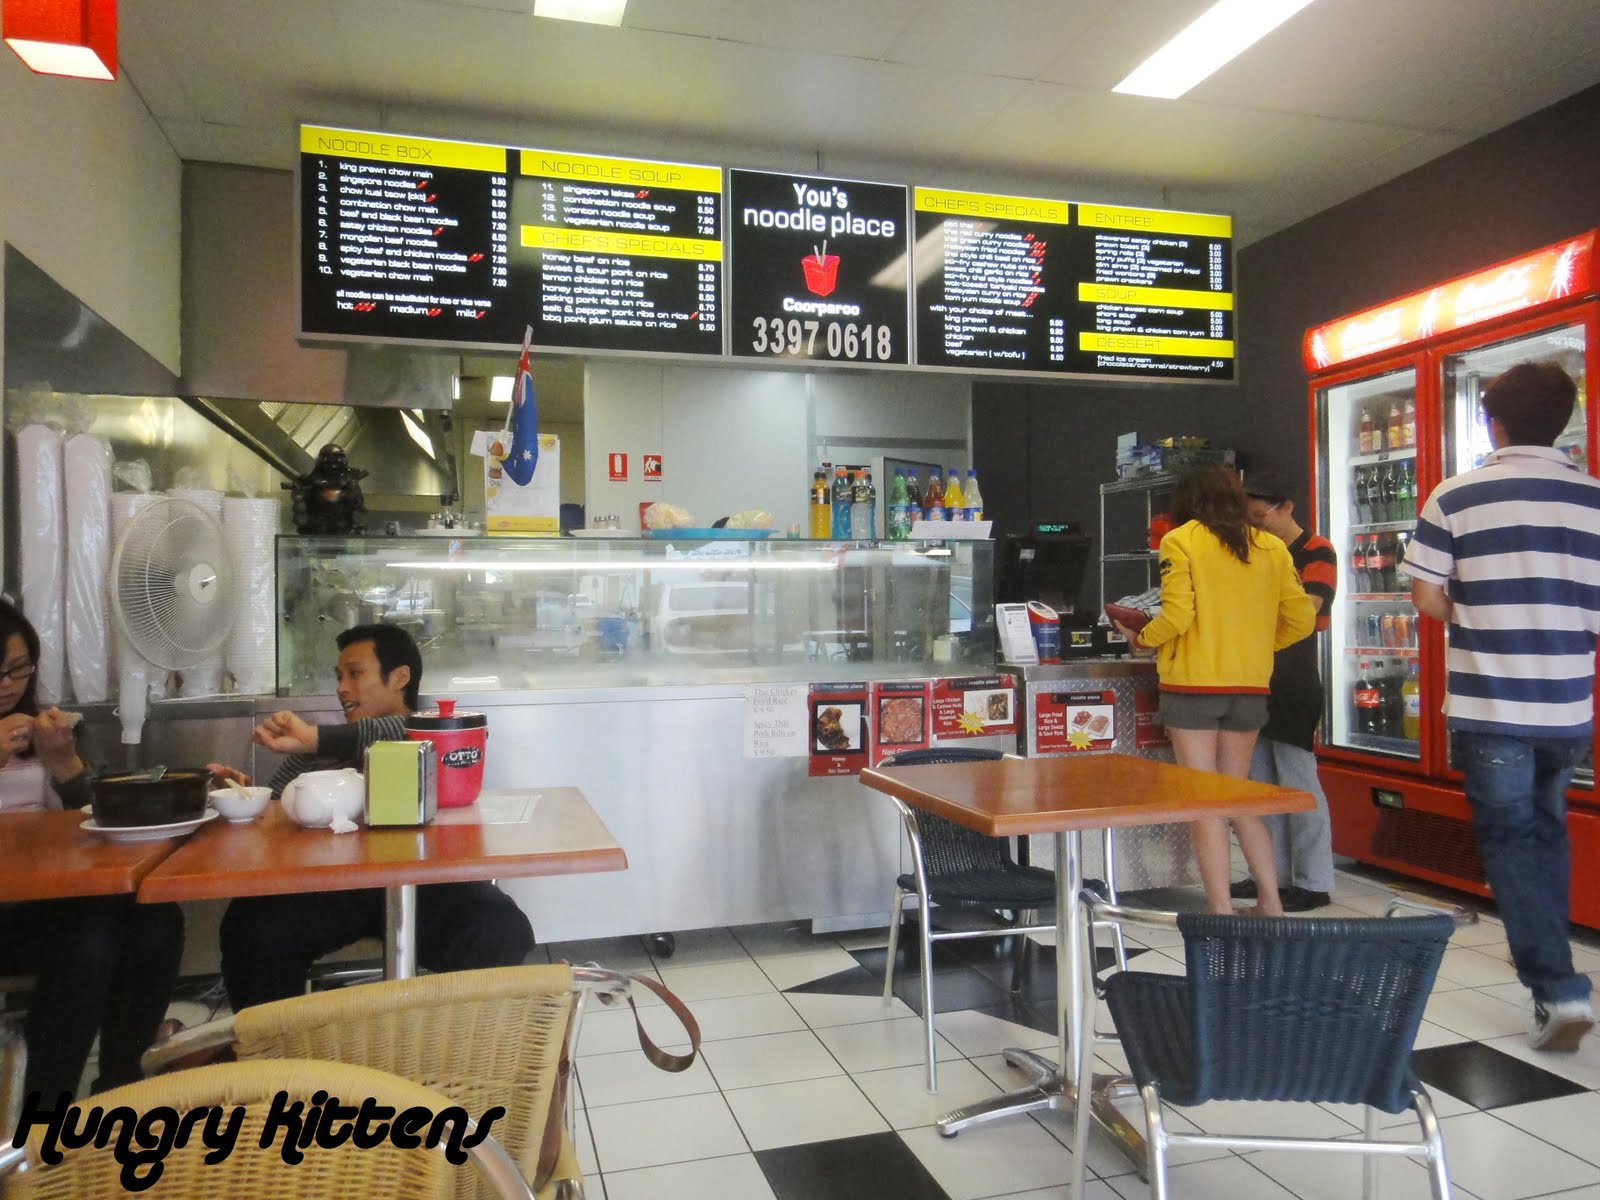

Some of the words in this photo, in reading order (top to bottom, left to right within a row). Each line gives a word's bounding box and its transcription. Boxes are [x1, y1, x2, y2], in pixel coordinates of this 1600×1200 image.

[318, 137, 390, 156] NOODLE
[397, 146, 432, 160] BOX
[541, 160, 623, 178] NOODLE
[629, 169, 682, 183] SOUP
[793, 183, 848, 208] You's
[924, 196, 979, 212] CHEF'S
[985, 203, 1058, 219] SPECIALS
[744, 208, 826, 232] noodle
[831, 212, 895, 238] place
[542, 232, 609, 247] CHEF'S
[616, 237, 705, 254] SPECIALS
[1096, 288, 1137, 300] SOUP
[456, 309, 476, 318] mild
[783, 297, 860, 317] Coorparoo
[752, 316, 819, 356] 3397
[827, 322, 891, 360] 0618
[1097, 337, 1162, 350] DESSERT
